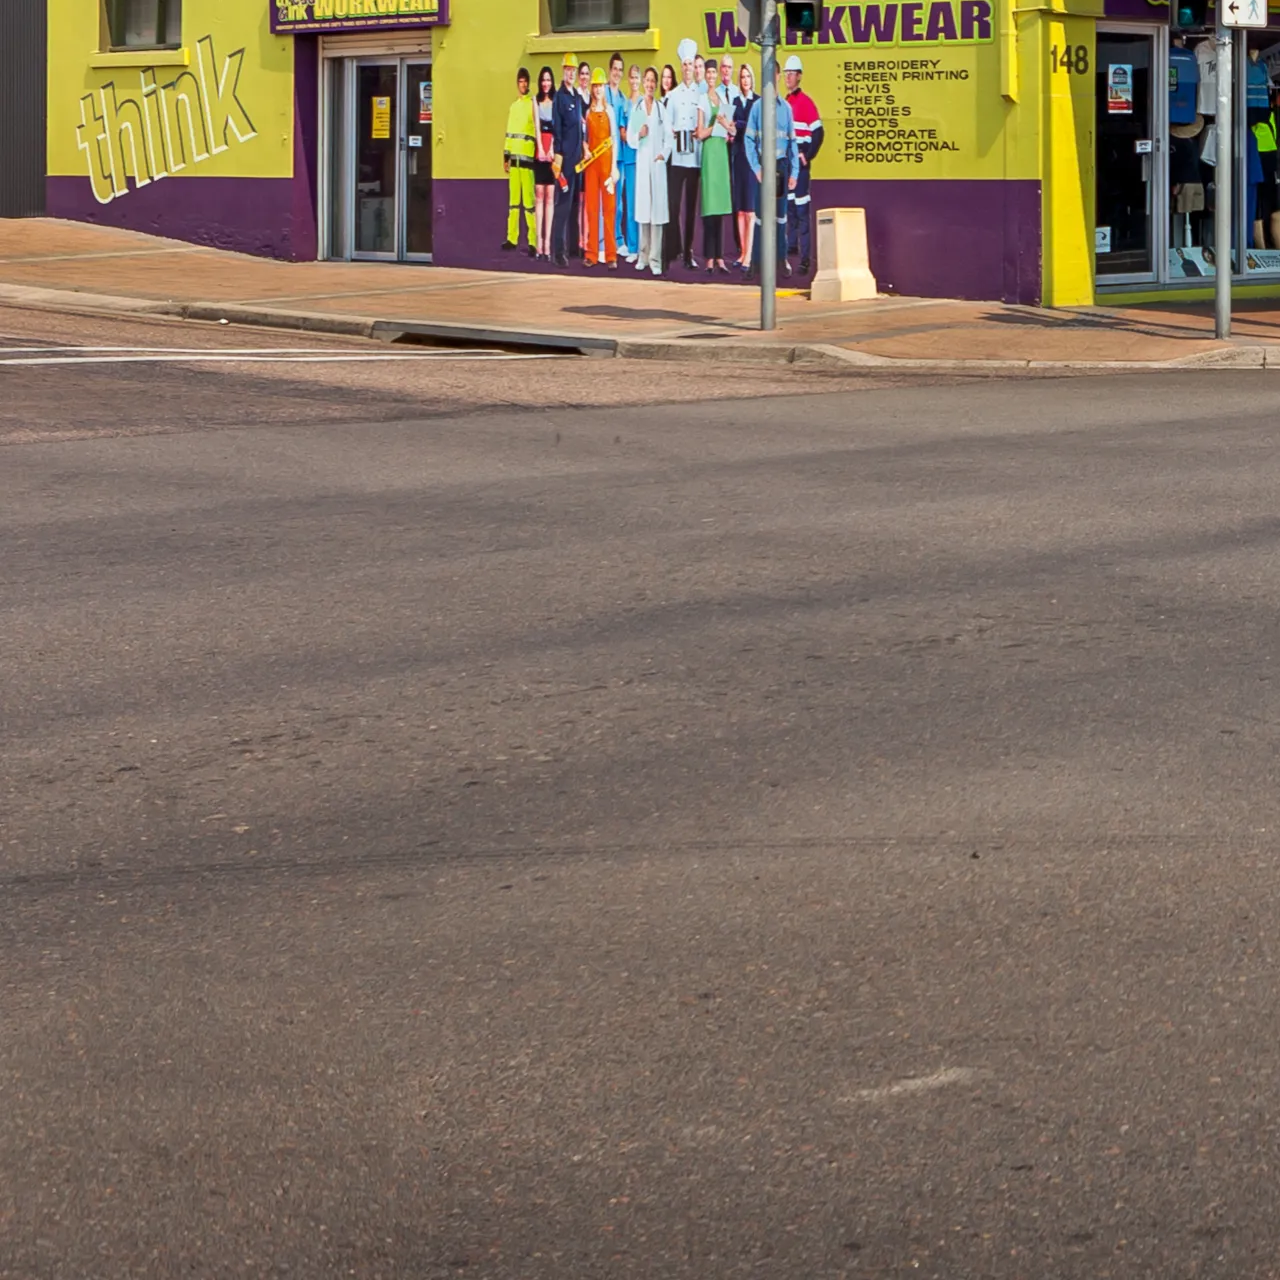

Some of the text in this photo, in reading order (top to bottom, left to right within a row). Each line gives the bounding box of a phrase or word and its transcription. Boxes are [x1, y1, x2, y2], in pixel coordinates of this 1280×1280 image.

[704, 0, 992, 48] WKWEAR
[844, 59, 941, 71] EMBROIDERY
[1050, 44, 1089, 75] 148
[844, 69, 969, 82] SCREEN PRINTING
[844, 83, 890, 94] HI-VIS
[844, 106, 912, 117] TRADIES
[76, 34, 258, 204] think
[844, 118, 898, 128] BOOTS
[844, 129, 937, 140] CORPORATE
[844, 141, 960, 152] PROMOTIONAL
[844, 152, 924, 163] PRODUCTS
